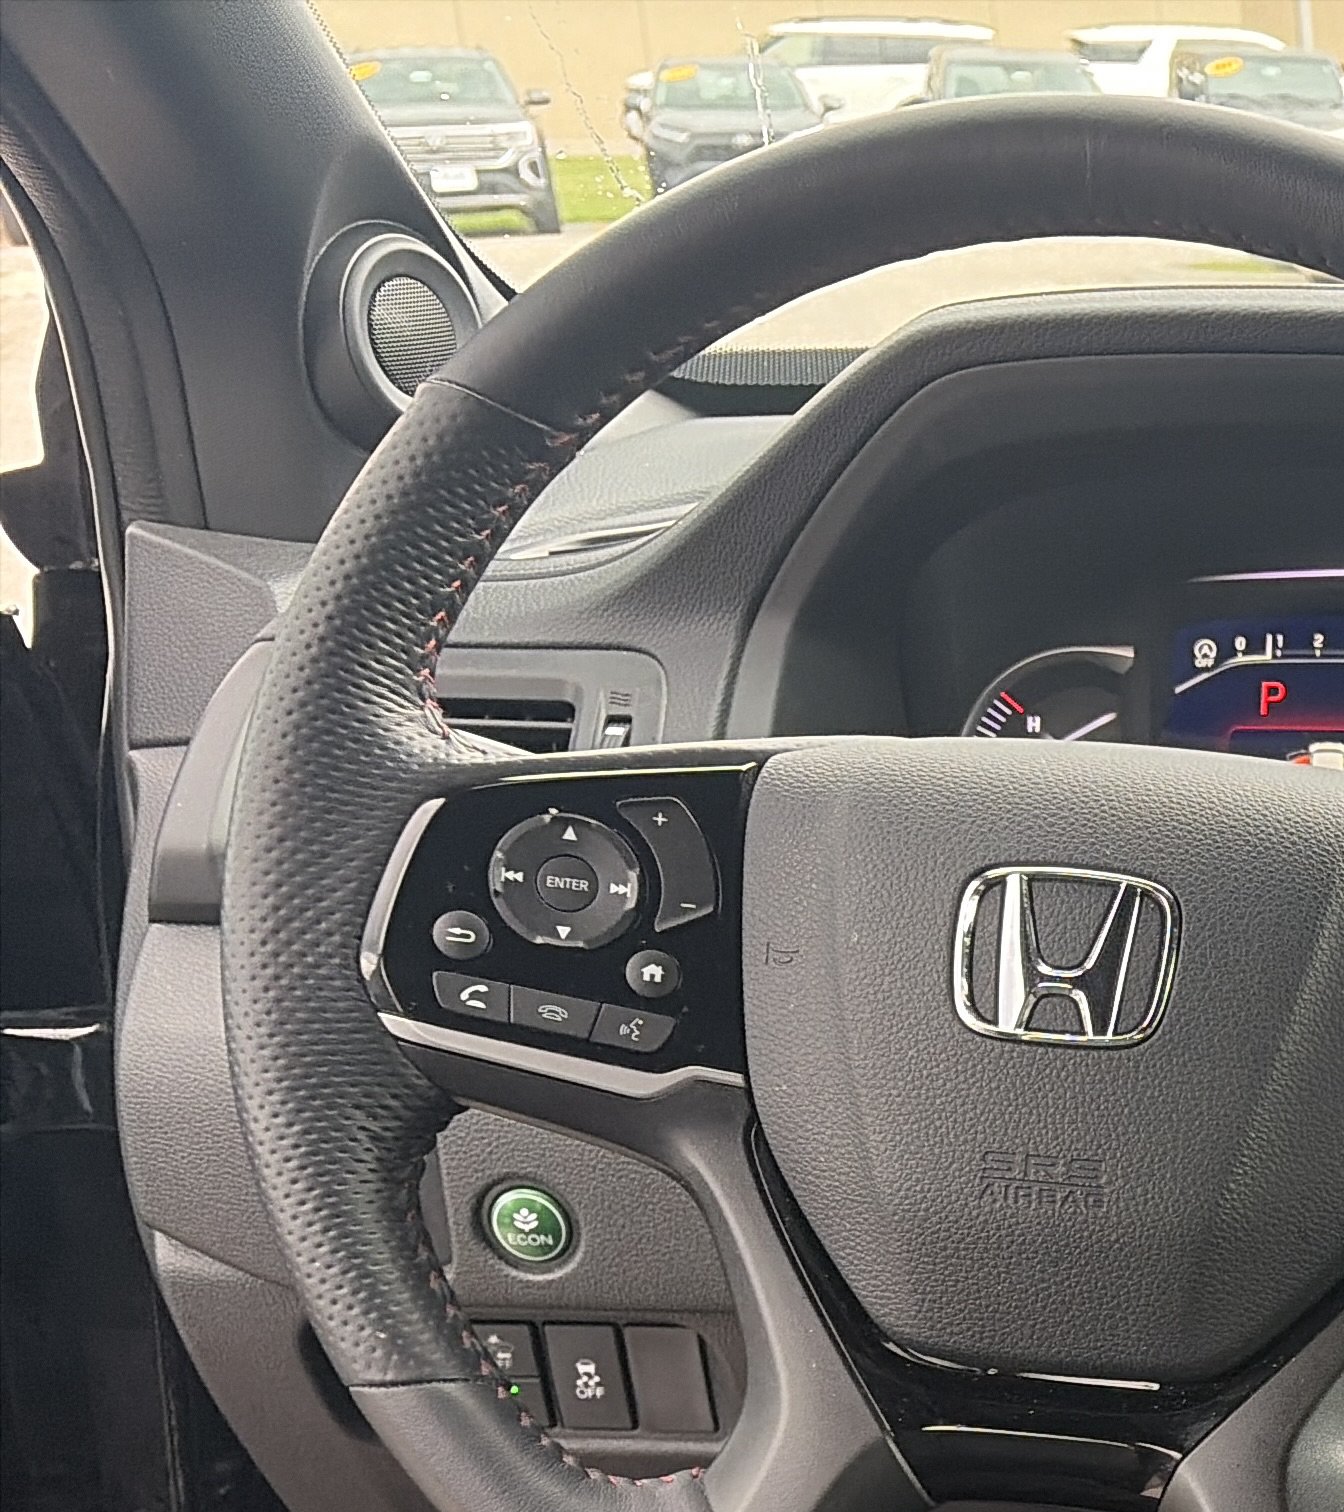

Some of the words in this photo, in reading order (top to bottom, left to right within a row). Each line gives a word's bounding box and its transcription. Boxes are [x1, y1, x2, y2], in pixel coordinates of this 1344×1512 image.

[1234, 635, 1247, 650] 0
[1275, 633, 1284, 649] 1
[1313, 633, 1325, 648] 2
[1259, 681, 1288, 717] P
[1026, 715, 1041, 733] H
[545, 876, 590, 893] ENTER
[507, 1231, 554, 1246] ECON
[575, 1386, 605, 1400] OFF
